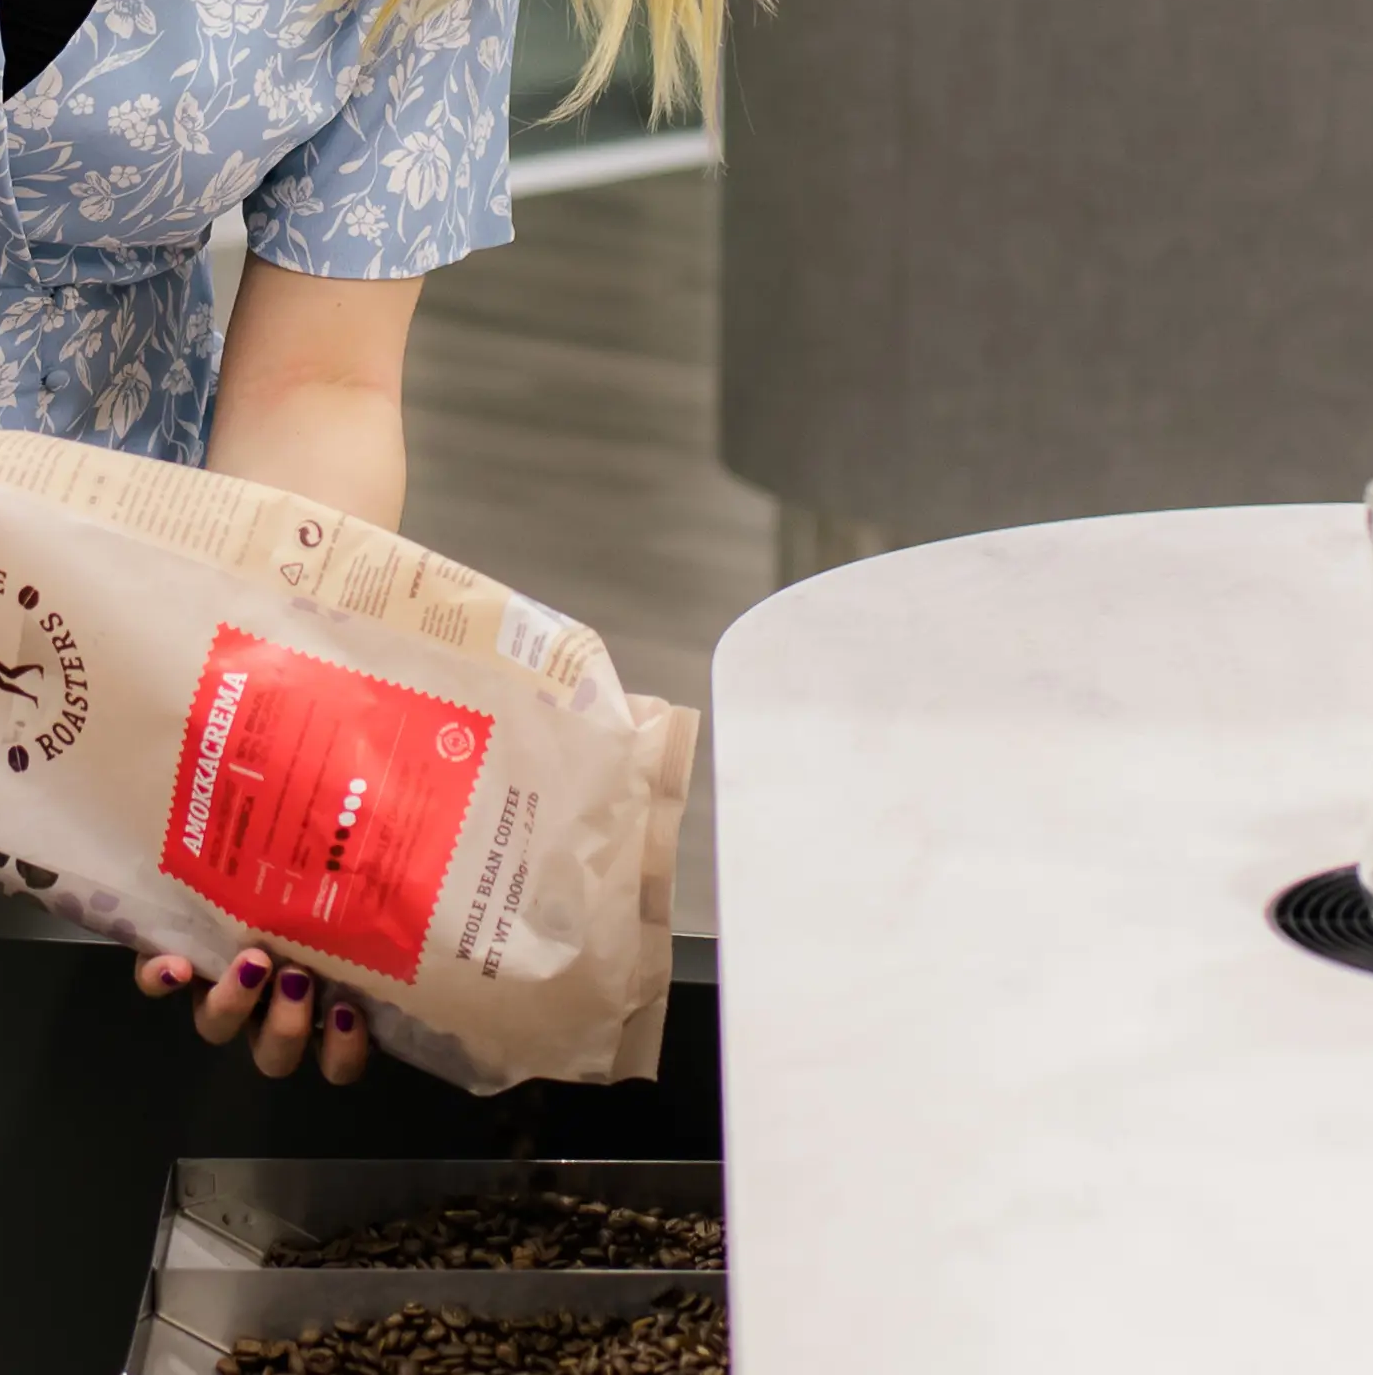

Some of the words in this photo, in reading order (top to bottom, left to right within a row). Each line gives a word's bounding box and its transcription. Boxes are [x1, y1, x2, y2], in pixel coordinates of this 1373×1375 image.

[35, 612, 89, 761] ROASTERS
[182, 672, 248, 858] AMOKKACREMA
[456, 899, 487, 961] WHOLE
[477, 849, 504, 897] BEAN
[494, 785, 520, 847] COFFEE
[481, 947, 503, 980] NET
[493, 917, 513, 945] WT
